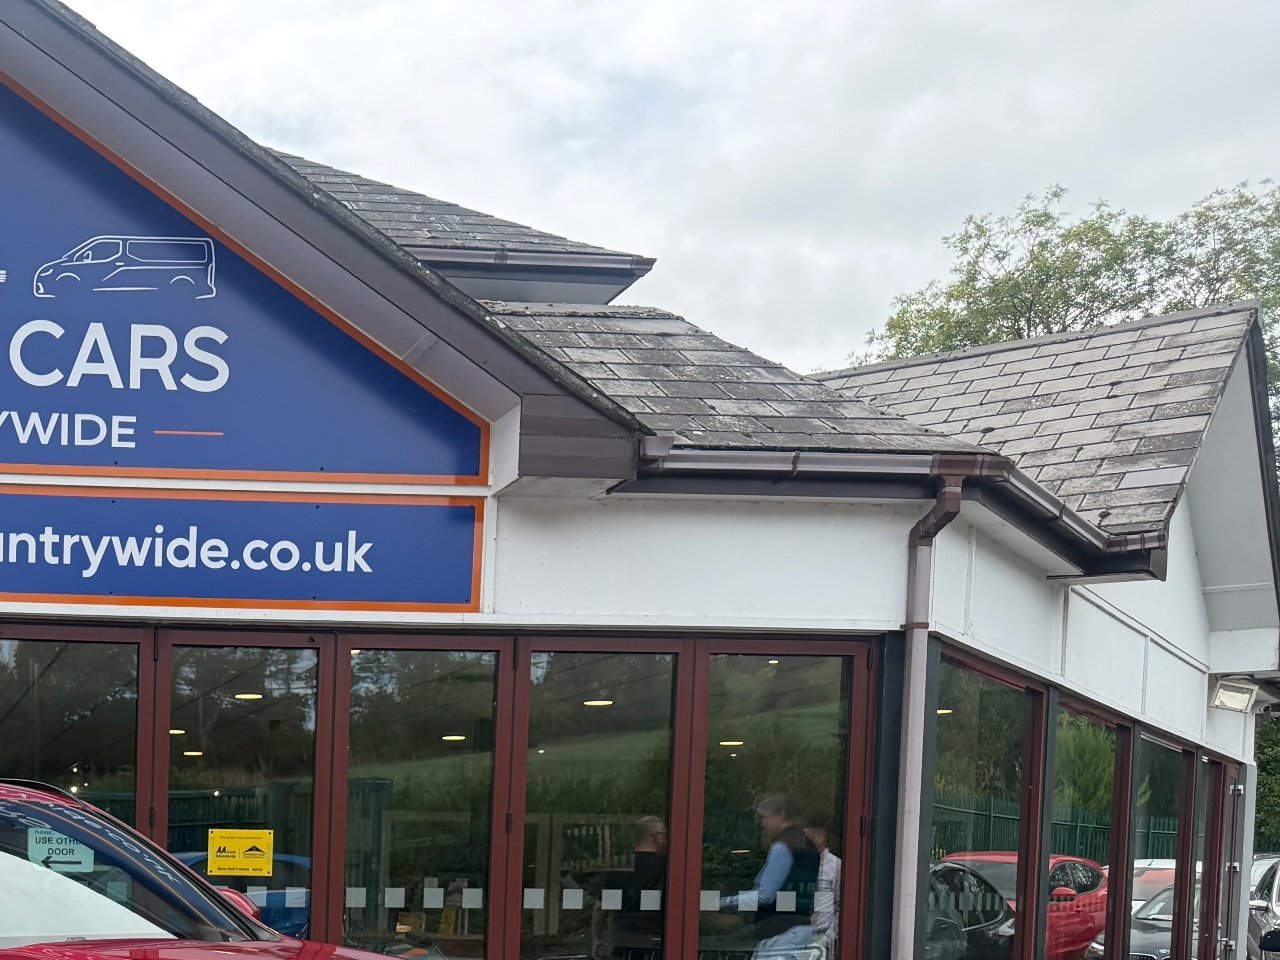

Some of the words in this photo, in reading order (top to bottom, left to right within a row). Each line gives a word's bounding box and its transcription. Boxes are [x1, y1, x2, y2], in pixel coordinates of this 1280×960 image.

[9, 319, 230, 393] CARS
[35, 836, 54, 845] USE
[56, 837, 81, 846] OTHE
[47, 847, 75, 856] DOOR
